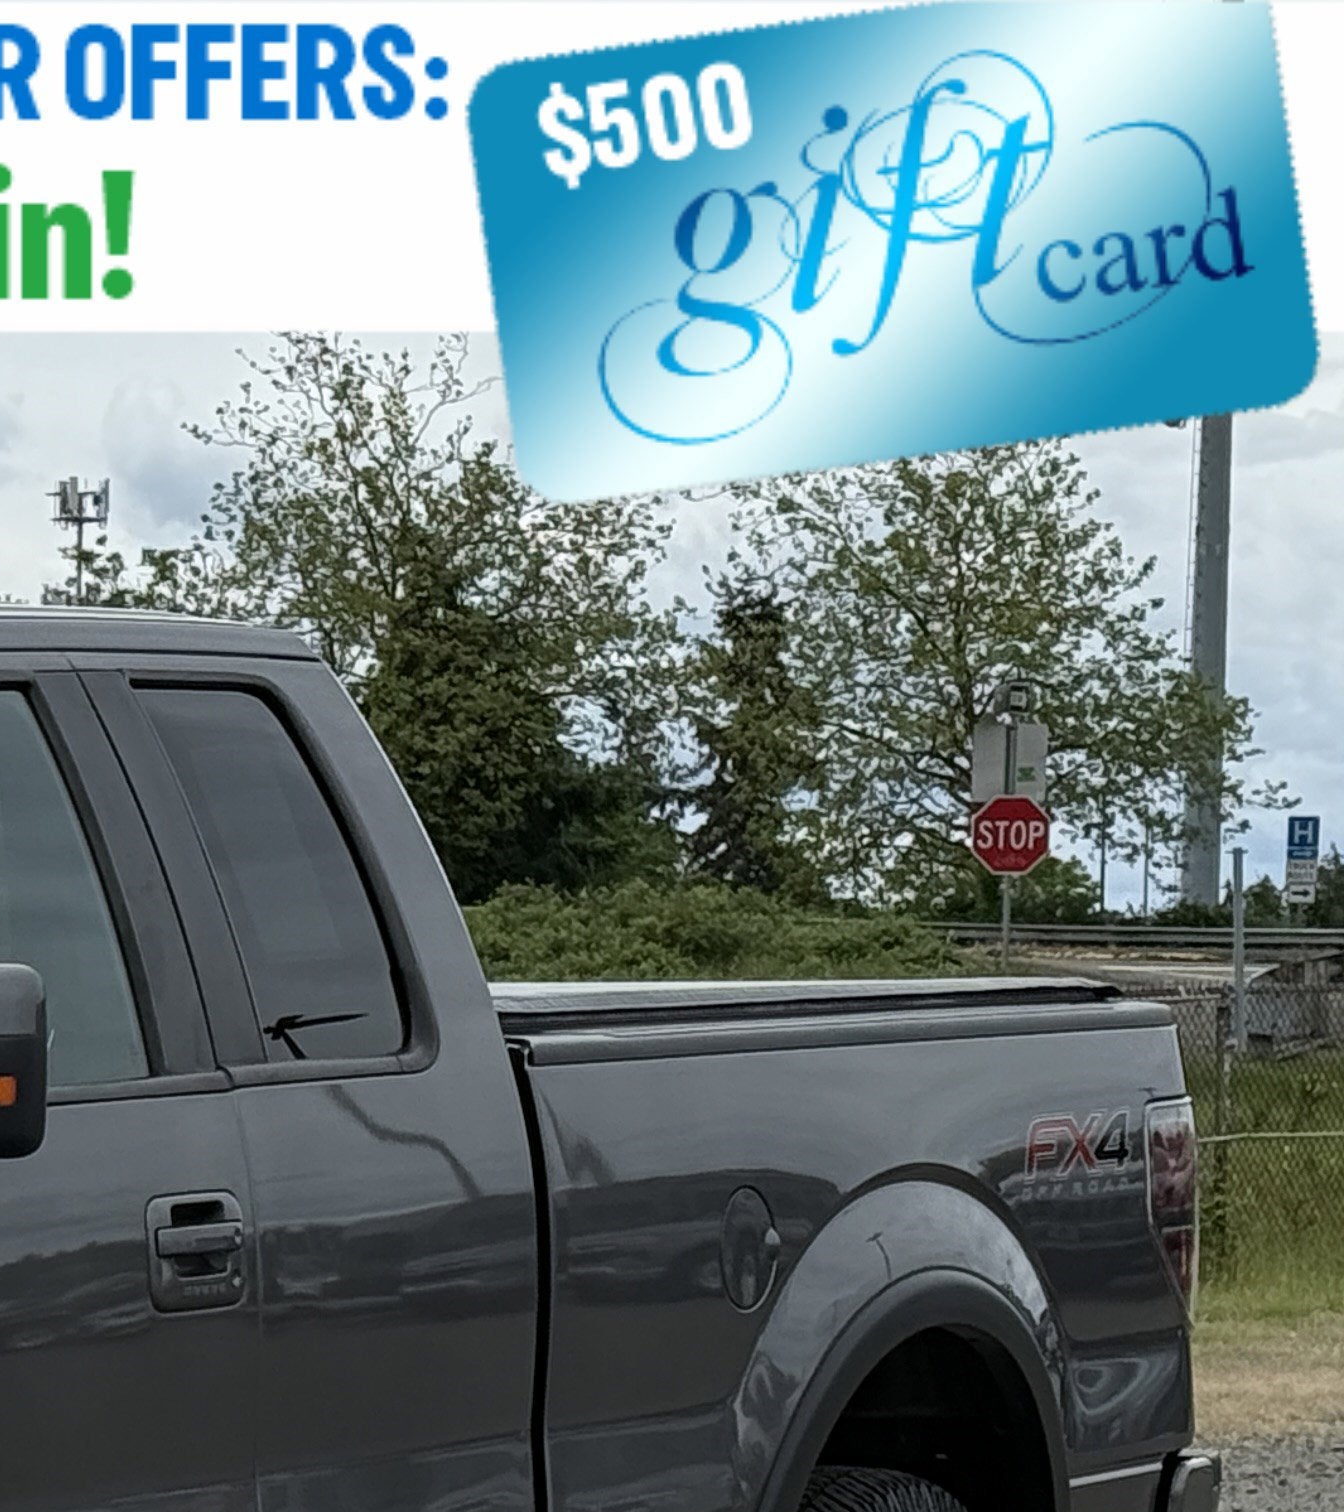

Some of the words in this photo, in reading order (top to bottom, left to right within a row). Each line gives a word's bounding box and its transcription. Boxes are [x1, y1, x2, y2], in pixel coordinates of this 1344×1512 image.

[976, 820, 1045, 850] STOP
[1294, 820, 1313, 844] H
[1023, 1107, 1131, 1184] FX4
